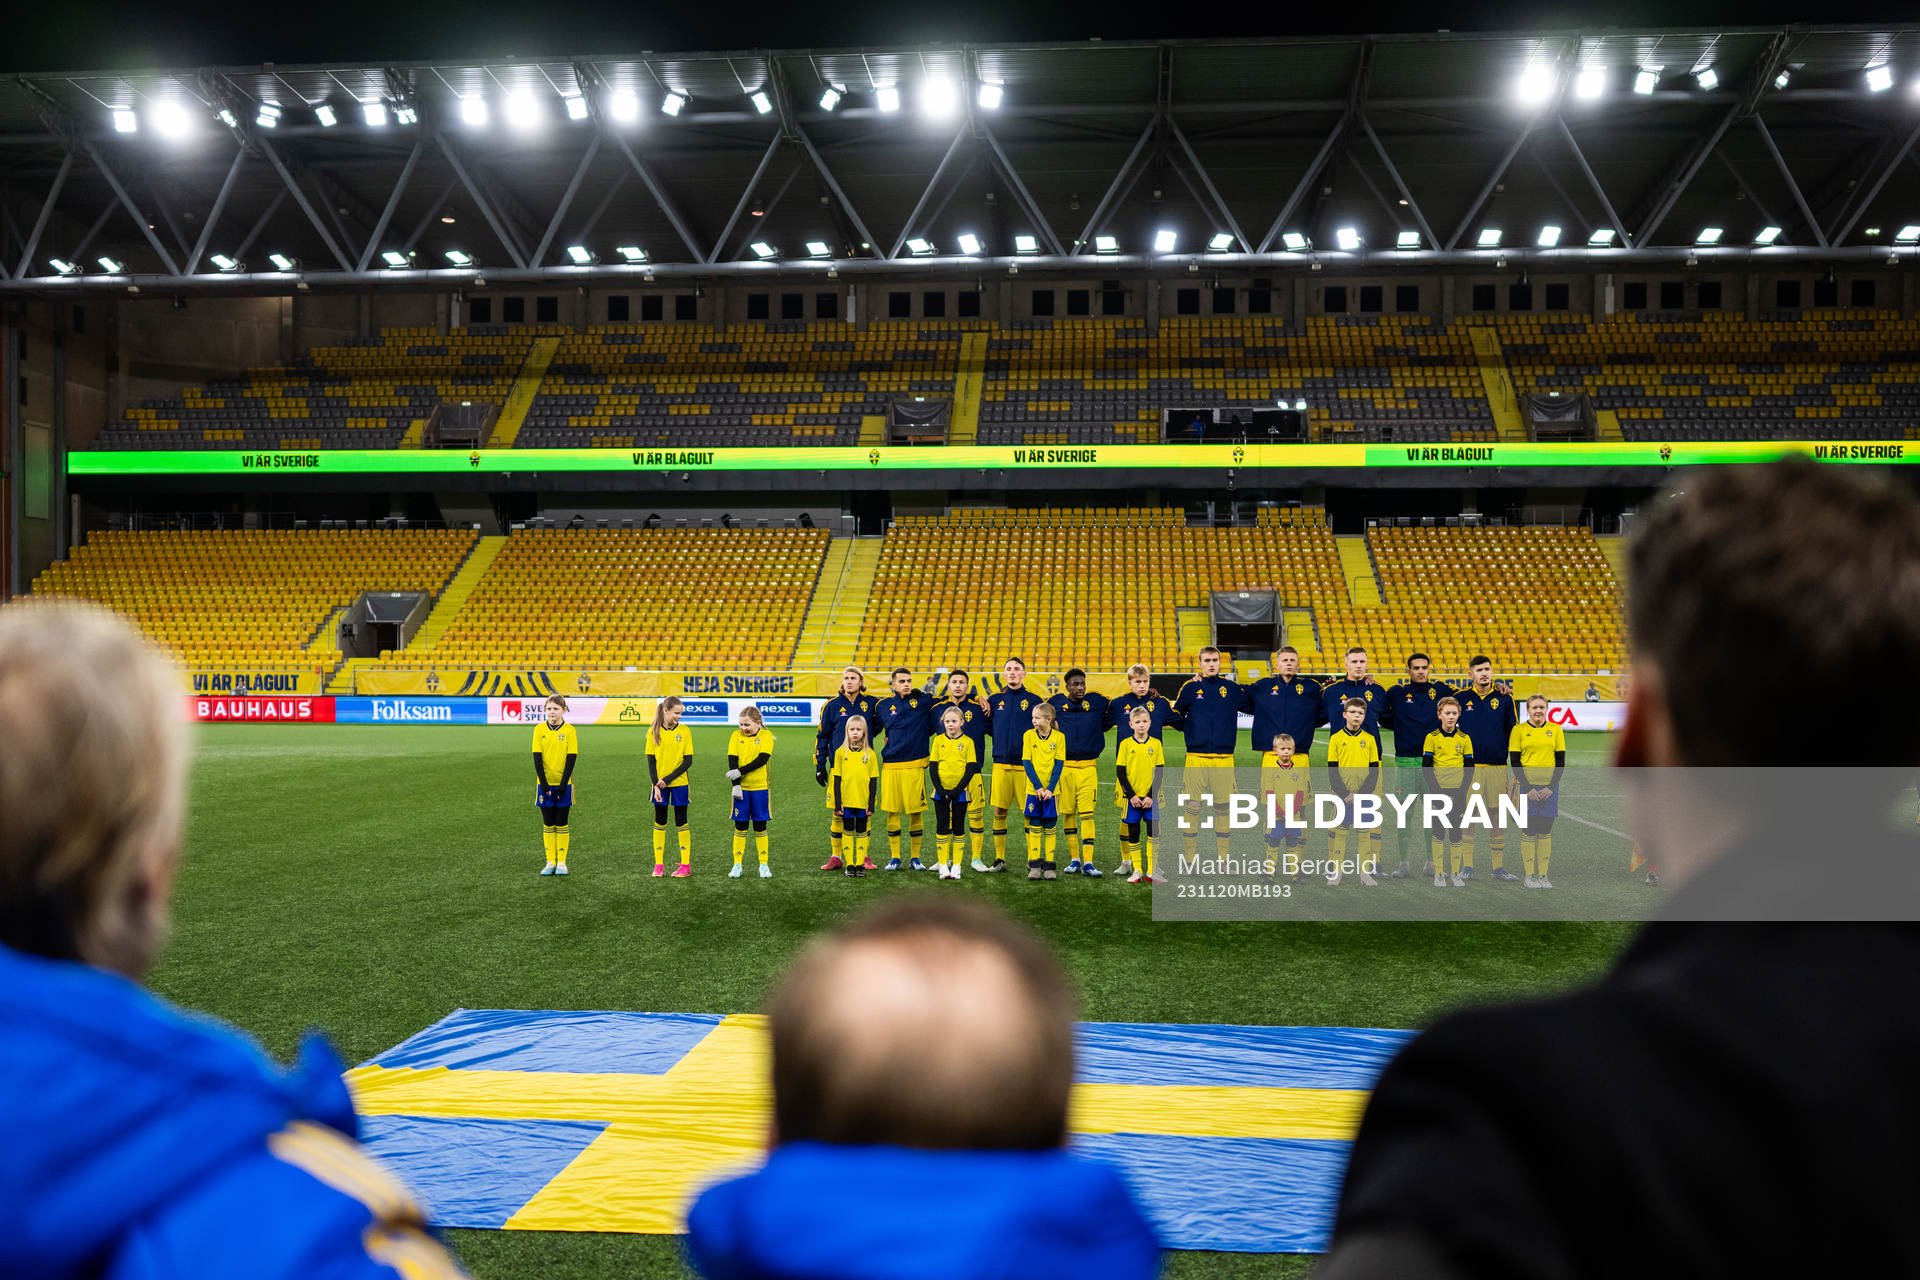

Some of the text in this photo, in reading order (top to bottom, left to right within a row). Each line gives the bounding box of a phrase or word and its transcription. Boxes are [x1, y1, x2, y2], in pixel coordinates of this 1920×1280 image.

[633, 452, 714, 465] VI ÄR BLÅGULT
[1014, 449, 1096, 462] VI ÄR SVERIGE
[1407, 447, 1494, 460] VI ÄR BLÅGULT
[1815, 445, 1904, 458] VI ÄR SVERIGE
[242, 455, 320, 467] VI ÄR SVERIGE
[193, 675, 208, 691] VI
[211, 674, 232, 691] ÄR
[684, 676, 793, 693] HEJA SVERIGE!
[197, 701, 311, 717] BAUHAUS
[372, 700, 452, 720] Folksam
[1548, 707, 1579, 725] CA
